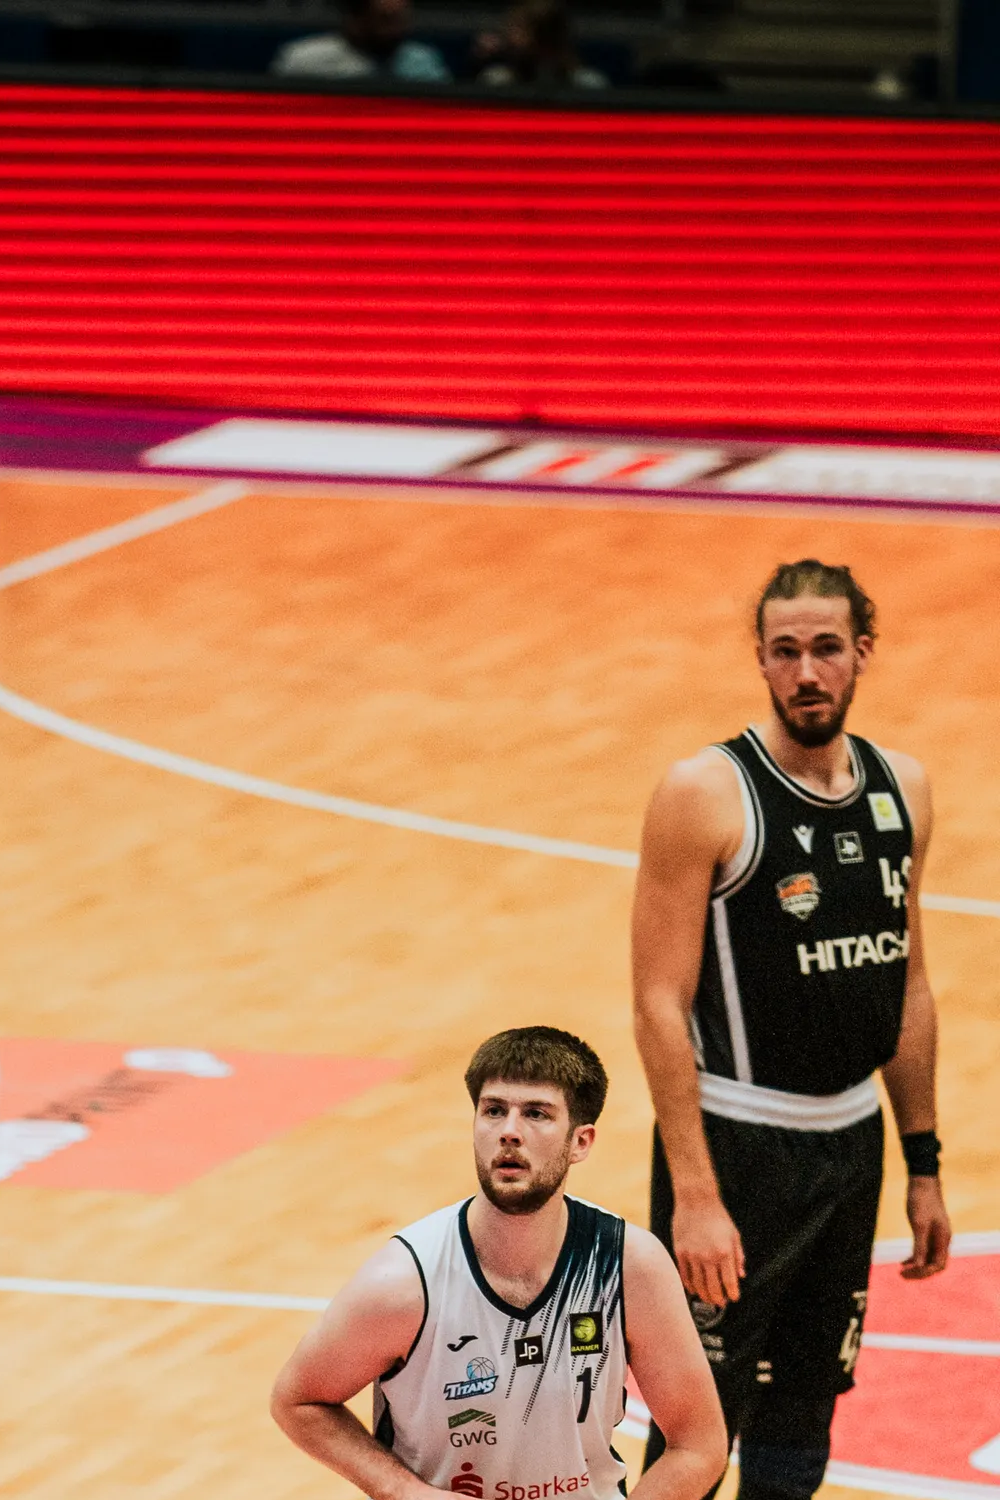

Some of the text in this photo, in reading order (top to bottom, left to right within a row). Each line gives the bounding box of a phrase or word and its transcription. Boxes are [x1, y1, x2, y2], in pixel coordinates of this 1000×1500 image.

[796, 929, 910, 976] HITACH
[571, 1344, 600, 1353] BARMER
[447, 1379, 496, 1399] TITANS
[576, 1367, 592, 1424] 1
[450, 1430, 497, 1448] GWG
